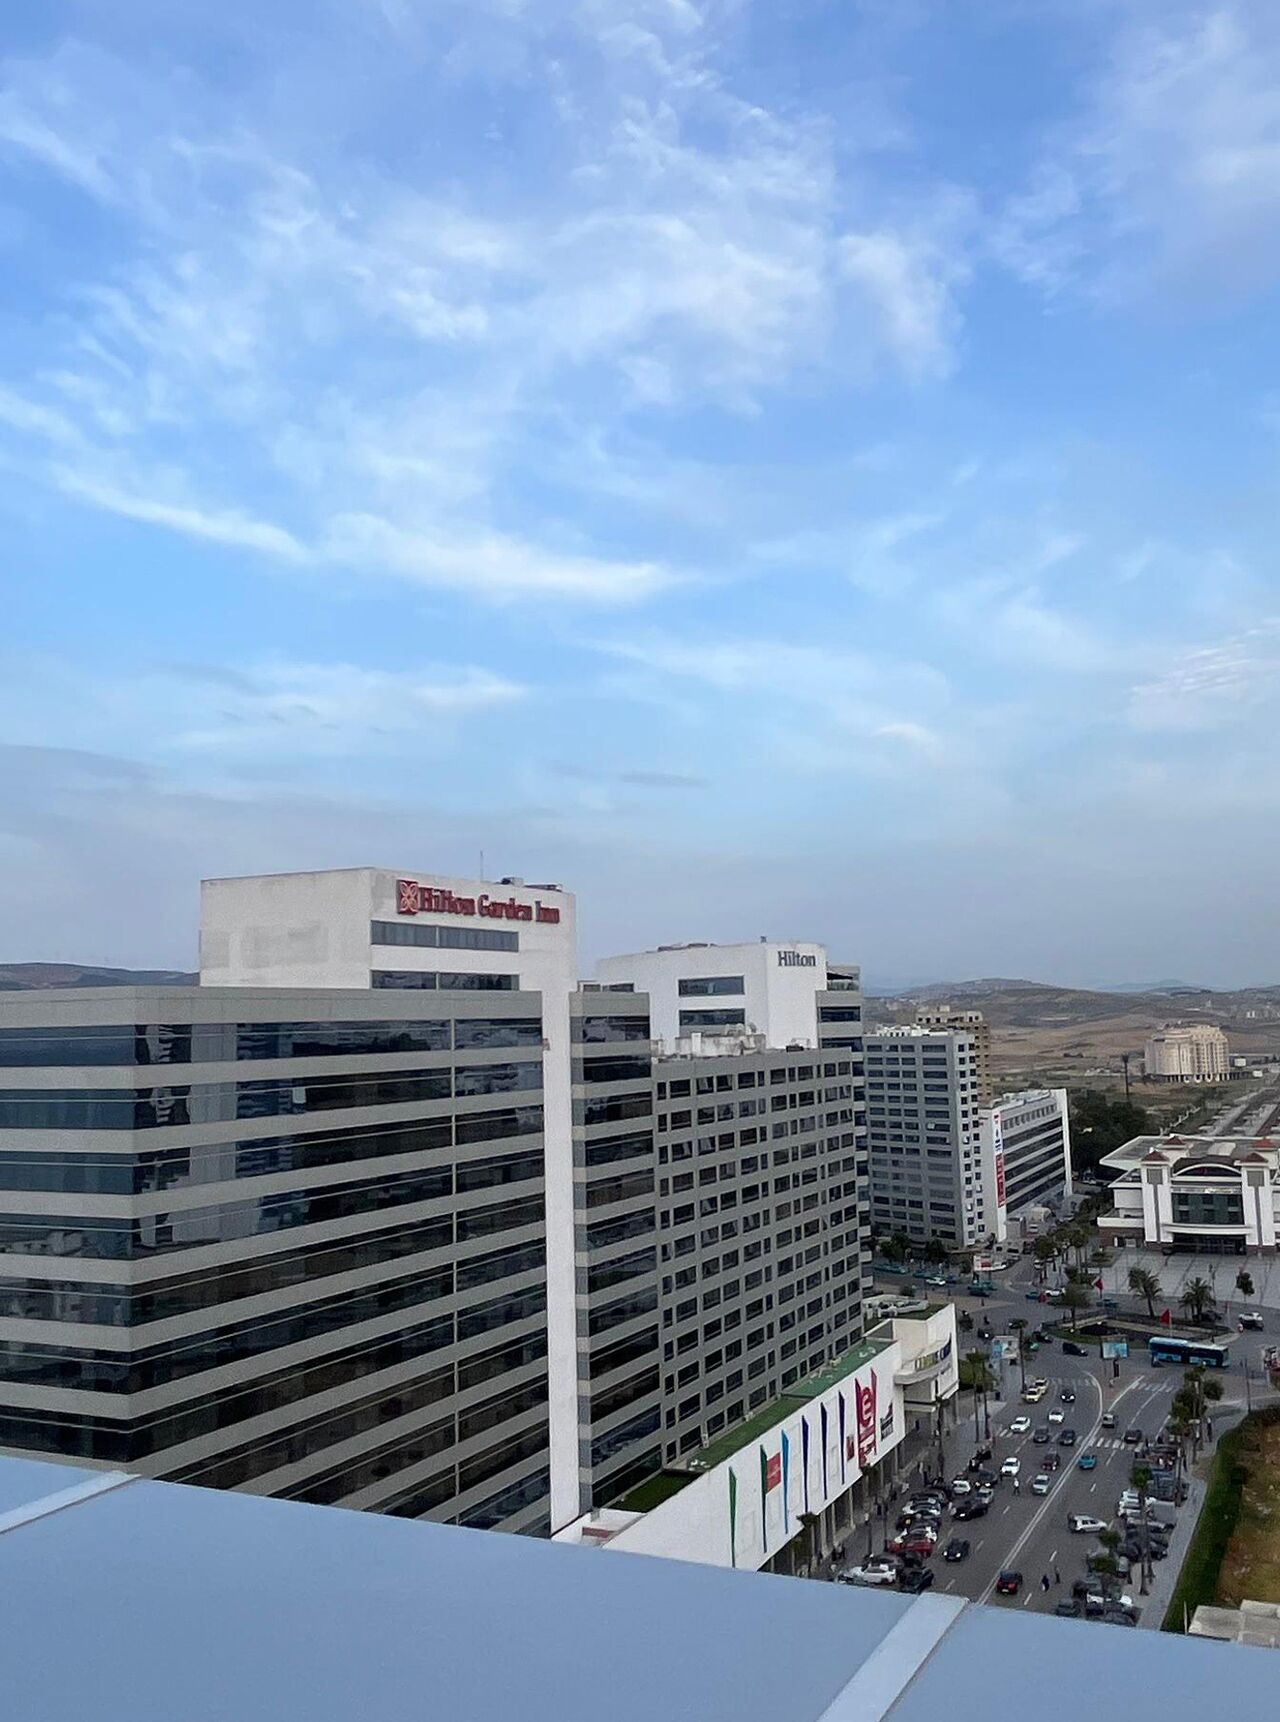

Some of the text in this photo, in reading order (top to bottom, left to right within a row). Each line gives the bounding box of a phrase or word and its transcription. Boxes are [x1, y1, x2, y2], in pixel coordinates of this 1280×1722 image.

[419, 887, 560, 924] Hilton Garden Inn
[777, 950, 816, 967] Hilton
